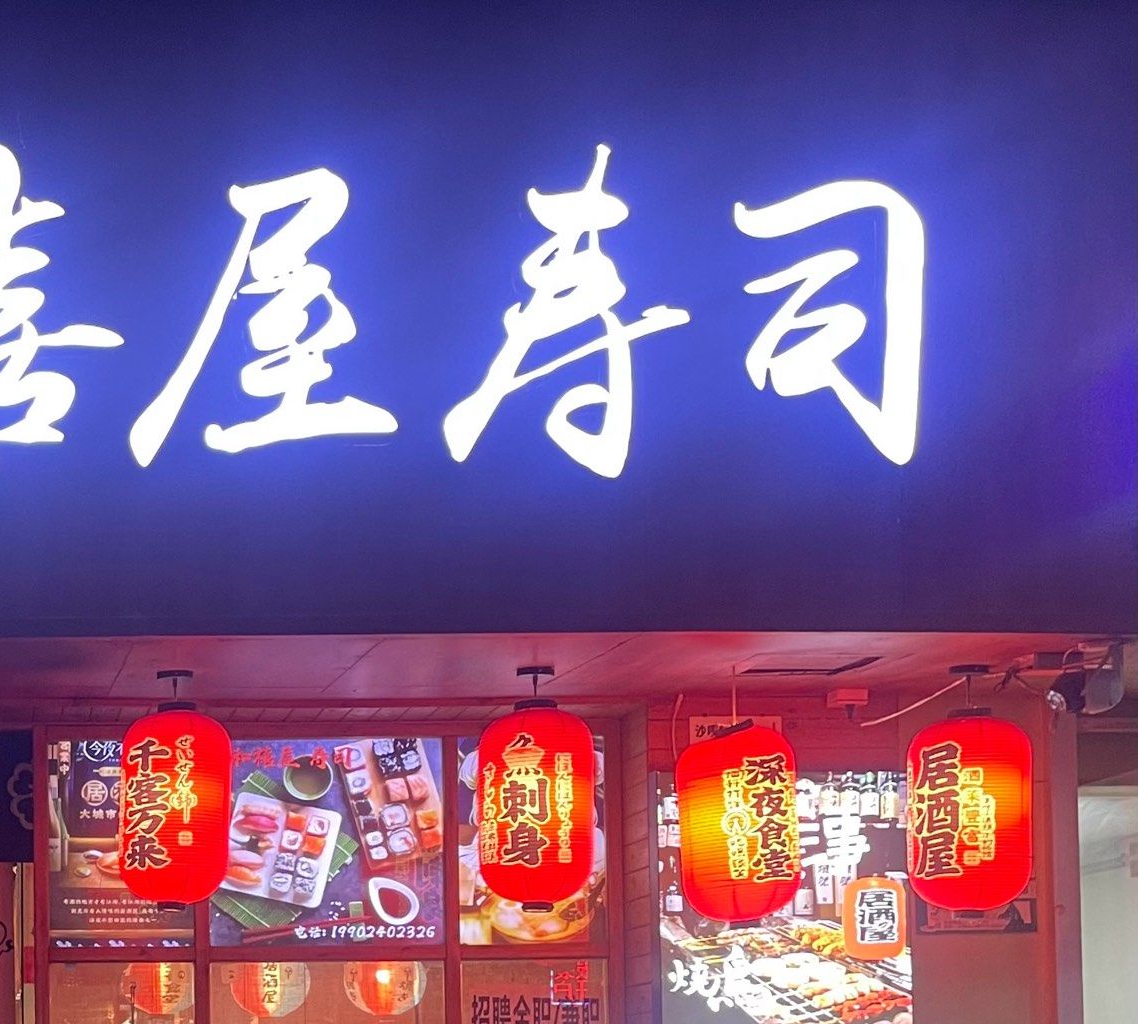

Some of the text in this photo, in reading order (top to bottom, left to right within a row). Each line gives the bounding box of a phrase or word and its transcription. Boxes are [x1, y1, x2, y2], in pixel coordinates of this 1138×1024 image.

[126, 739, 172, 869] 千客万来
[744, 755, 793, 881] 深夜食堂
[916, 743, 963, 878] 居酒屋
[331, 925, 436, 939] 19902402326
